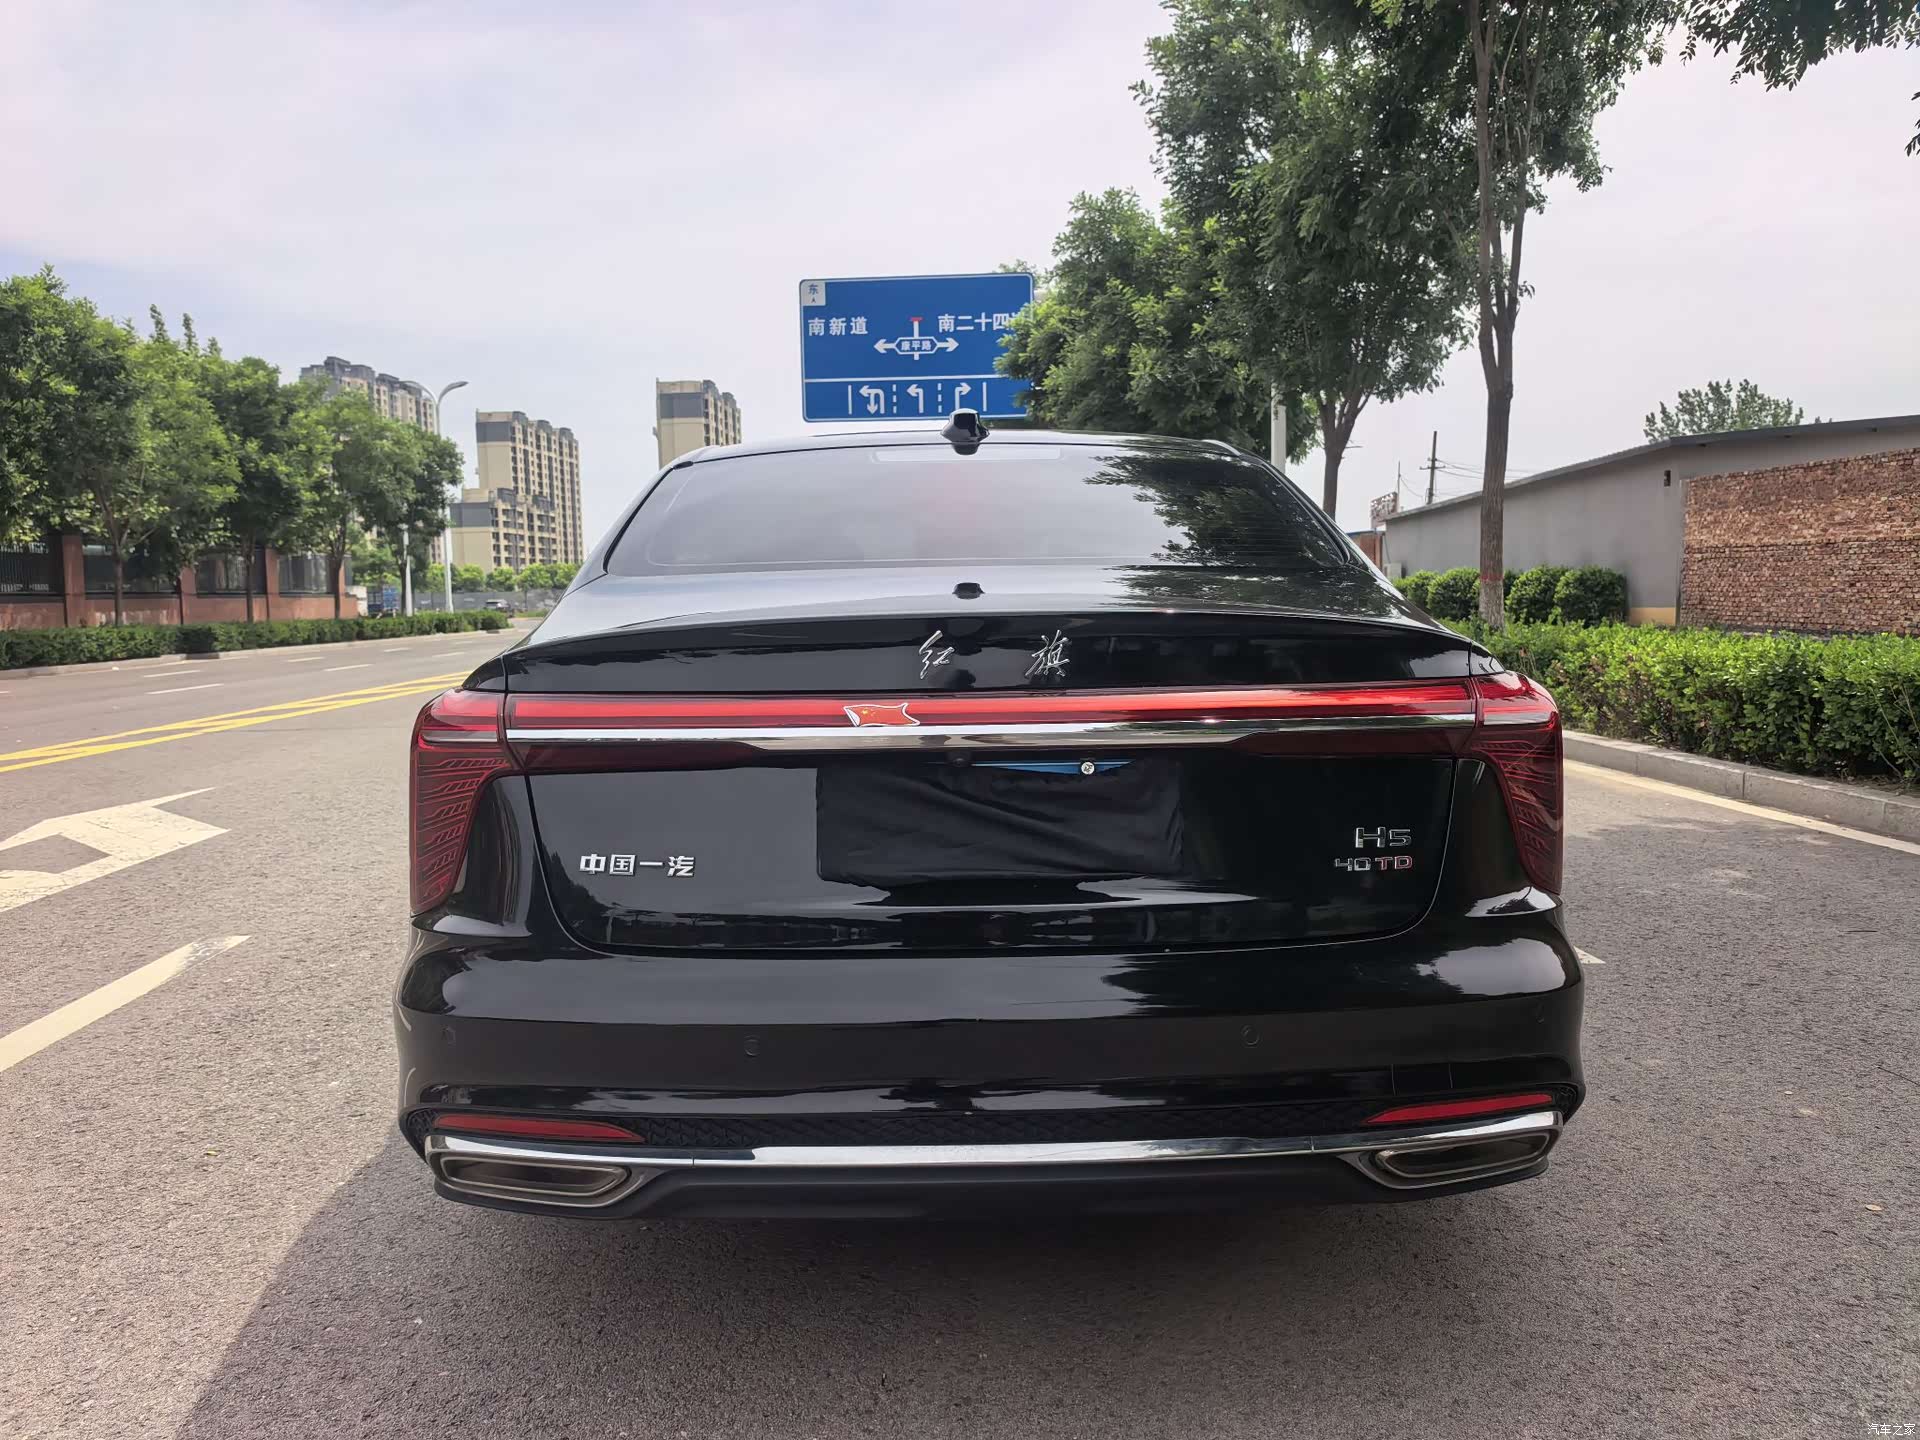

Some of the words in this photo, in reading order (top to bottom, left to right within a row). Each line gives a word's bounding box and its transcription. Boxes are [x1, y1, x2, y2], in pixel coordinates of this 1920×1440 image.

[808, 283, 819, 295] 东
[807, 316, 868, 336] 南新道
[937, 312, 1020, 333] 南二十四
[1355, 826, 1412, 848] H5
[579, 853, 696, 877] 中国一汽
[1334, 855, 1413, 872] 40TD
